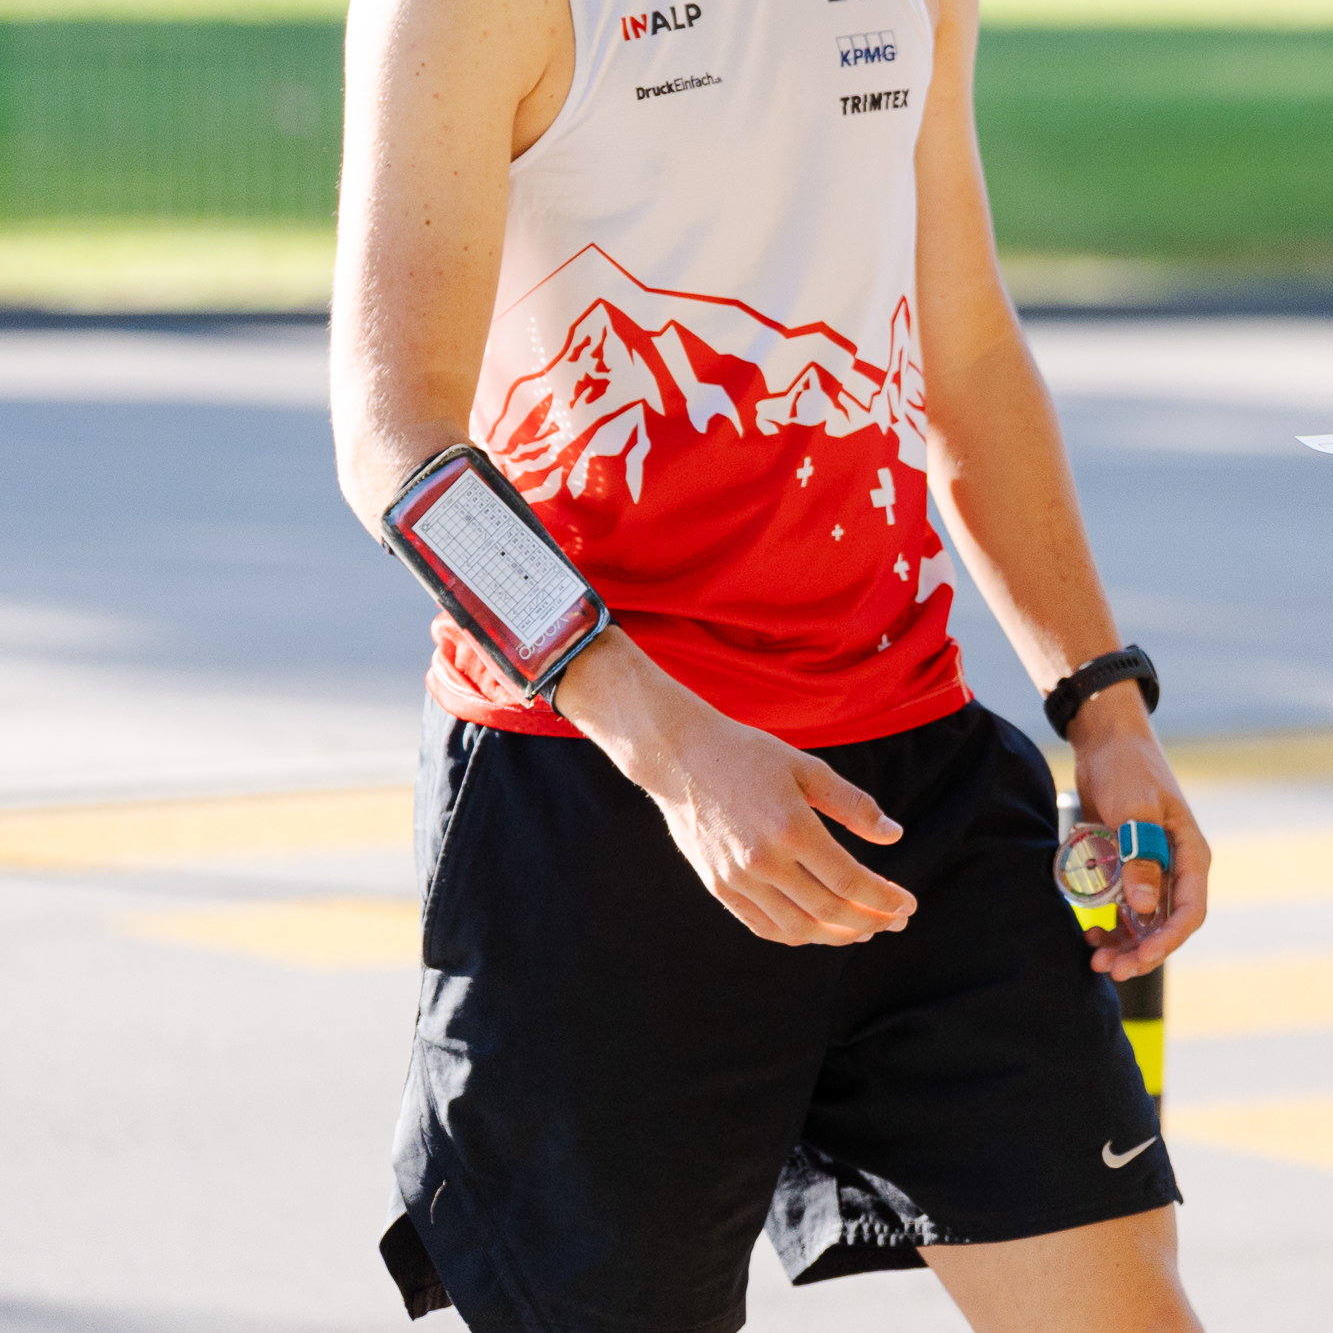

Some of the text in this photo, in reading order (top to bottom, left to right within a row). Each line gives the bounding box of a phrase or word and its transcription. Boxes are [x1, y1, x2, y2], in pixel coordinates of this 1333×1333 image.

[621, 3, 702, 41] INALP
[840, 44, 896, 67] KPMG
[840, 89, 909, 115] TRIMTEX
